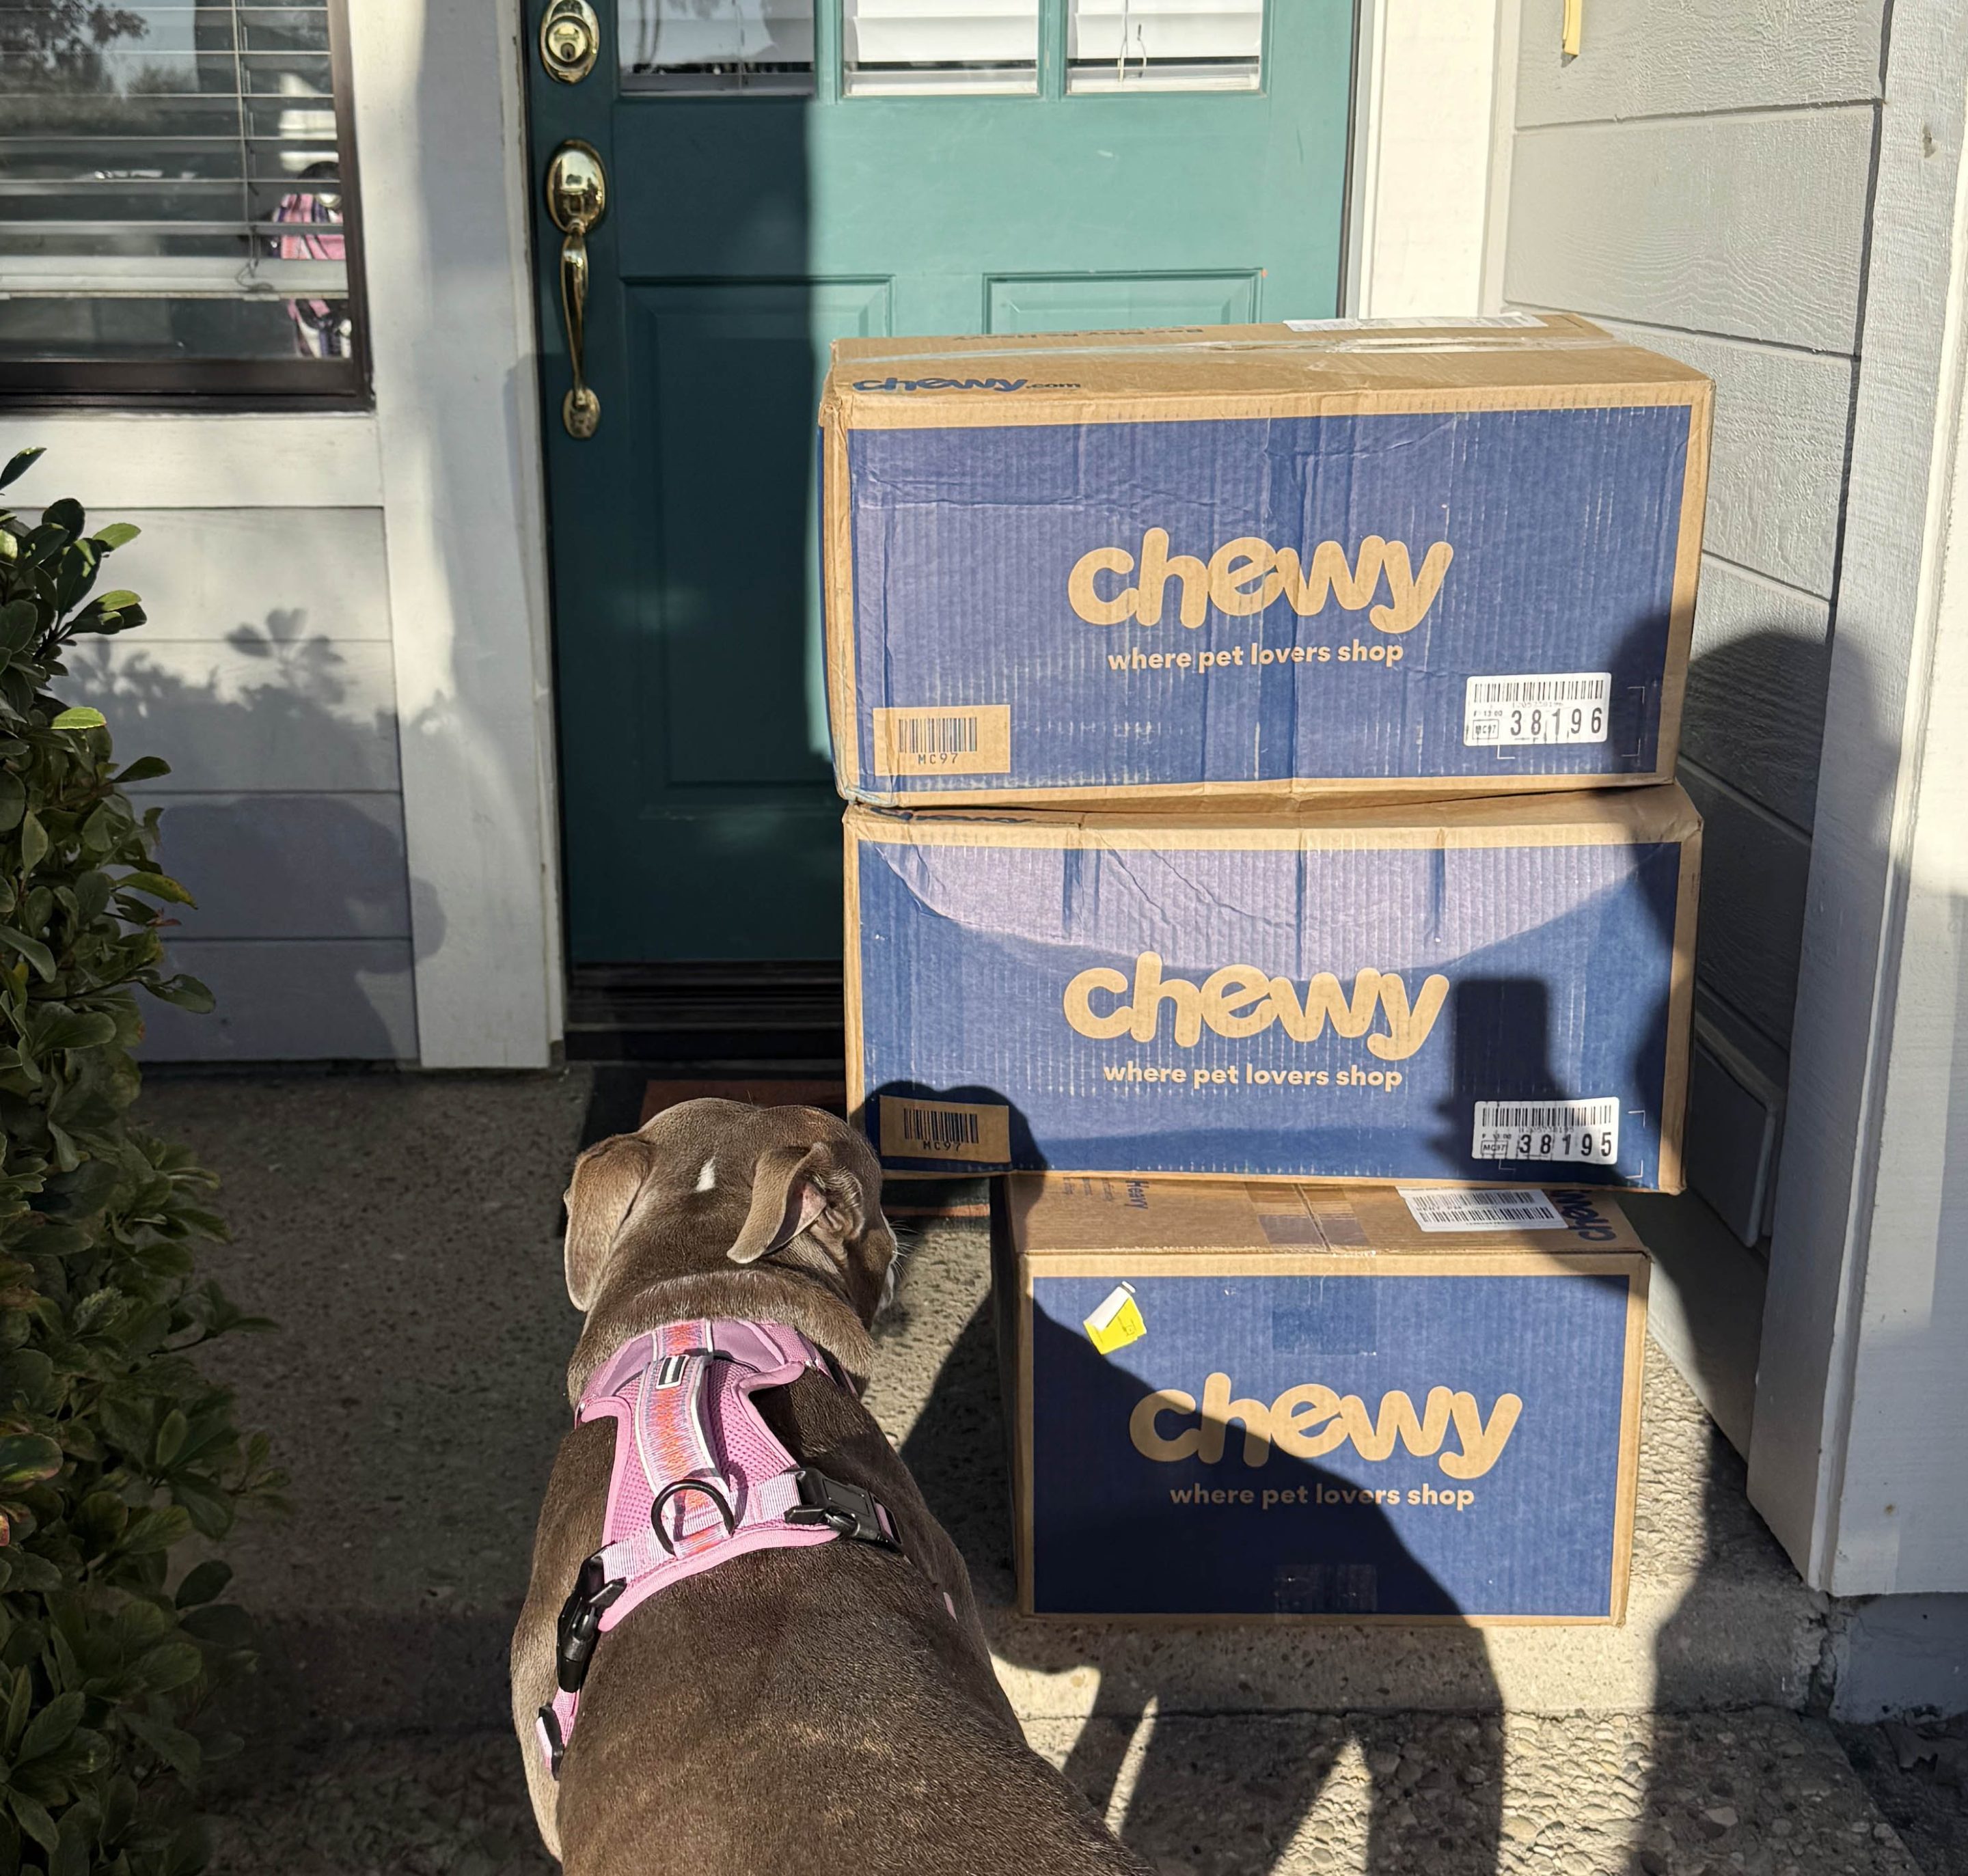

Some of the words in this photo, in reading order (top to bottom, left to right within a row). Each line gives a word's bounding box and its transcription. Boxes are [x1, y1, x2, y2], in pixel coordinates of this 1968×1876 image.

[853, 376, 1081, 392] chewy.com
[1067, 527, 1454, 634] chewy
[1107, 646, 1192, 670] where
[1199, 645, 1244, 674] pet
[1250, 642, 1331, 665] lovers
[1337, 638, 1404, 667] shop
[1510, 707, 1602, 736] 38196
[918, 753, 959, 764] MC97
[1063, 950, 1450, 1061] chewy
[1103, 1060, 1188, 1083] where
[1193, 1064, 1239, 1090] pet
[1246, 1062, 1330, 1086] lovers
[1335, 1064, 1403, 1092] shop
[923, 1141, 961, 1152] MC97
[1520, 1131, 1612, 1157] 38195
[1124, 1180, 1149, 1209] Heavy
[1548, 1189, 1617, 1241] chew
[1129, 1372, 1523, 1480] chewy
[1169, 1482, 1255, 1504] where
[1261, 1485, 1309, 1510] pet
[1316, 1482, 1401, 1505] lovers
[1407, 1482, 1475, 1512] shop
